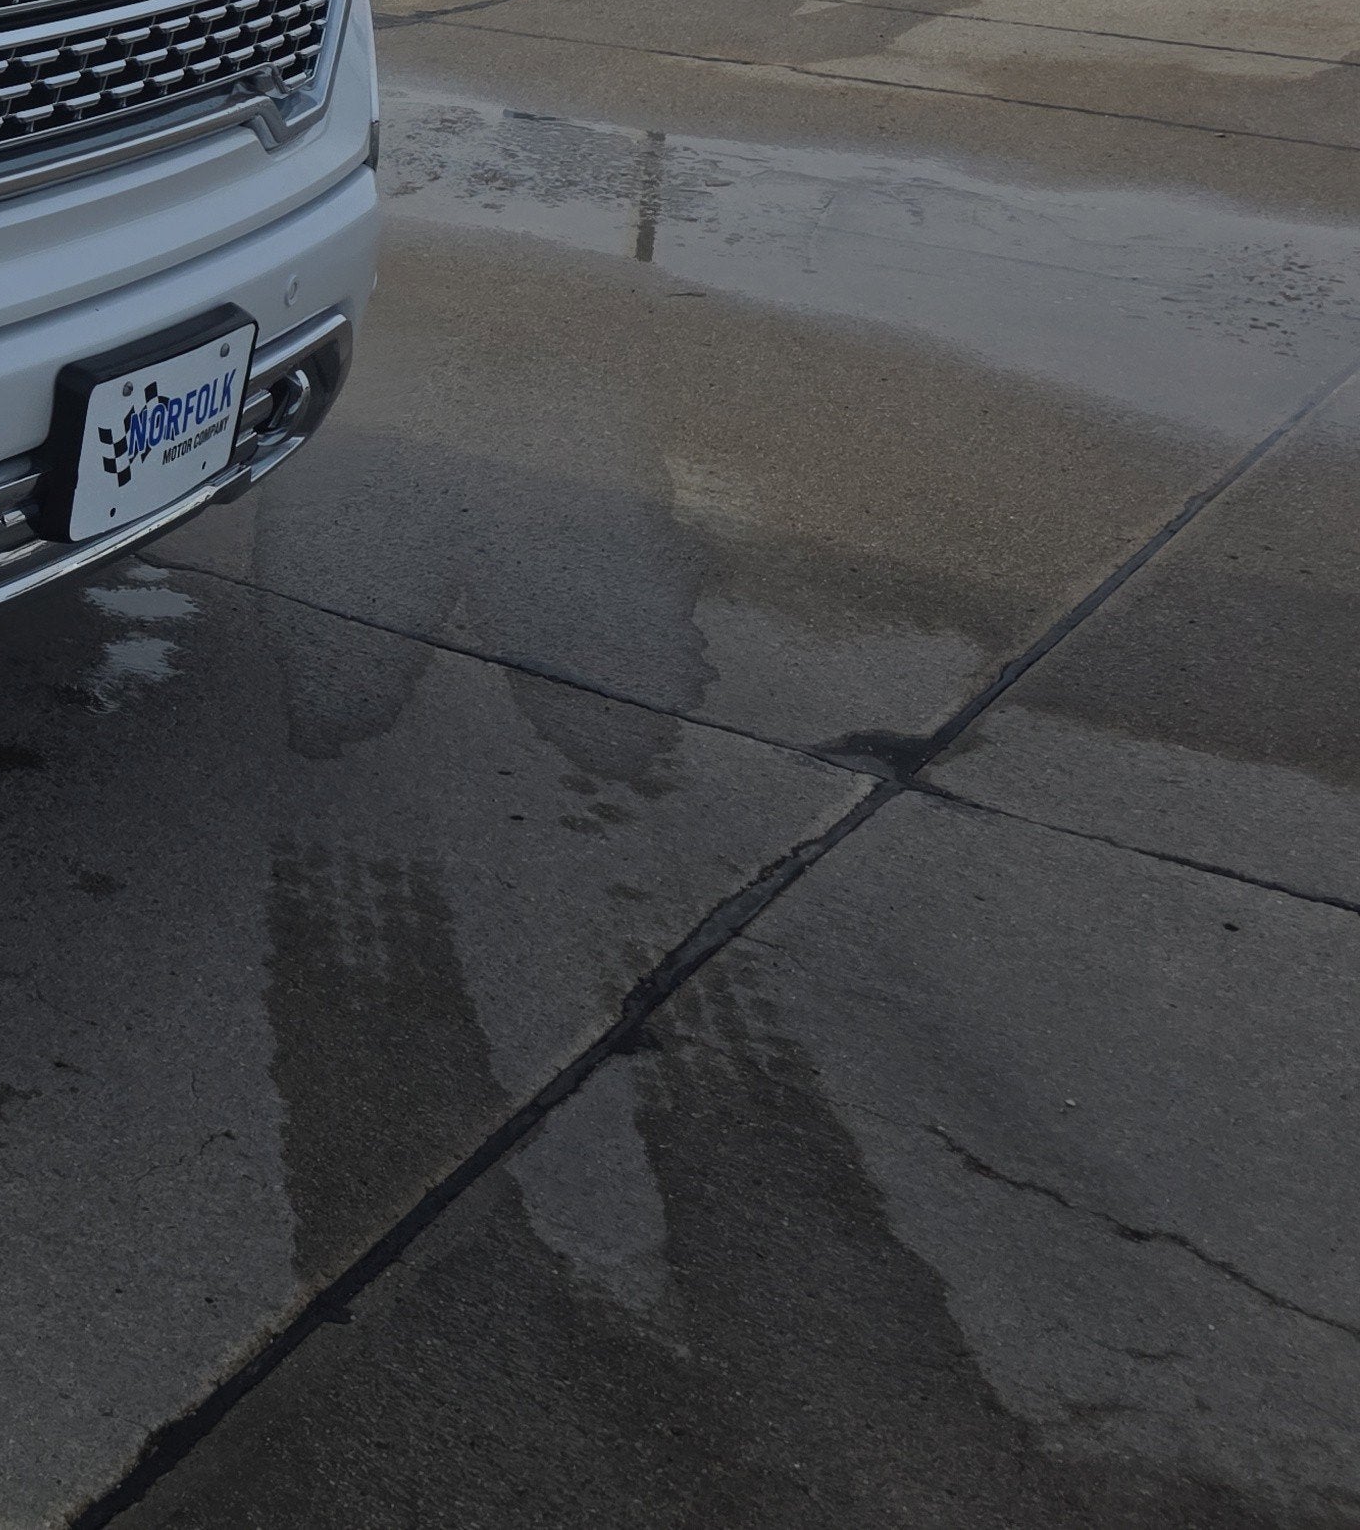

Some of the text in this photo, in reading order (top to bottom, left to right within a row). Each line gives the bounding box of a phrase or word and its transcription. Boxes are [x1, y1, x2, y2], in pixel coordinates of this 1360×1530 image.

[128, 369, 236, 456] NORFOLK
[162, 416, 230, 465] MOTOR COMPANY
